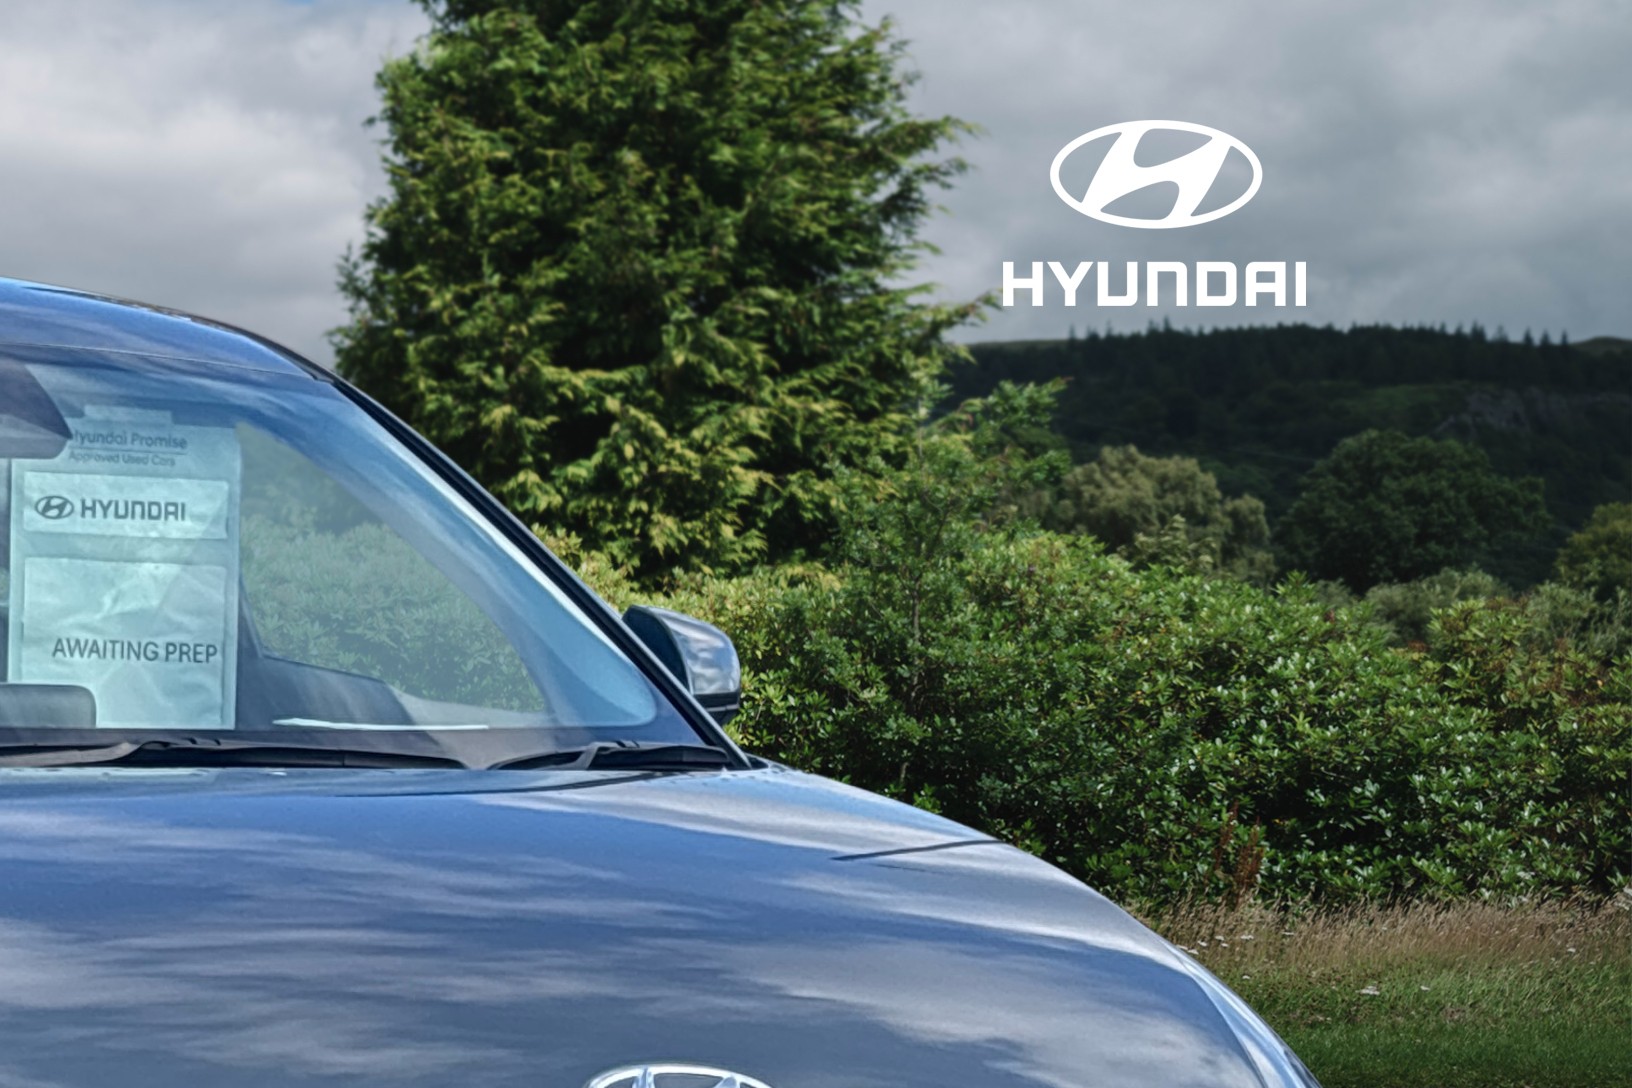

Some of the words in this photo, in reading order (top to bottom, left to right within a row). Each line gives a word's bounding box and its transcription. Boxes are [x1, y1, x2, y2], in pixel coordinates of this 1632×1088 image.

[131, 432, 188, 449] Promise
[69, 451, 120, 464] Approved
[122, 454, 150, 466] Used
[151, 455, 176, 468] Cars
[80, 499, 186, 522] HYUNDAI
[52, 638, 159, 662] AWAITING
[164, 642, 218, 664] PREP
